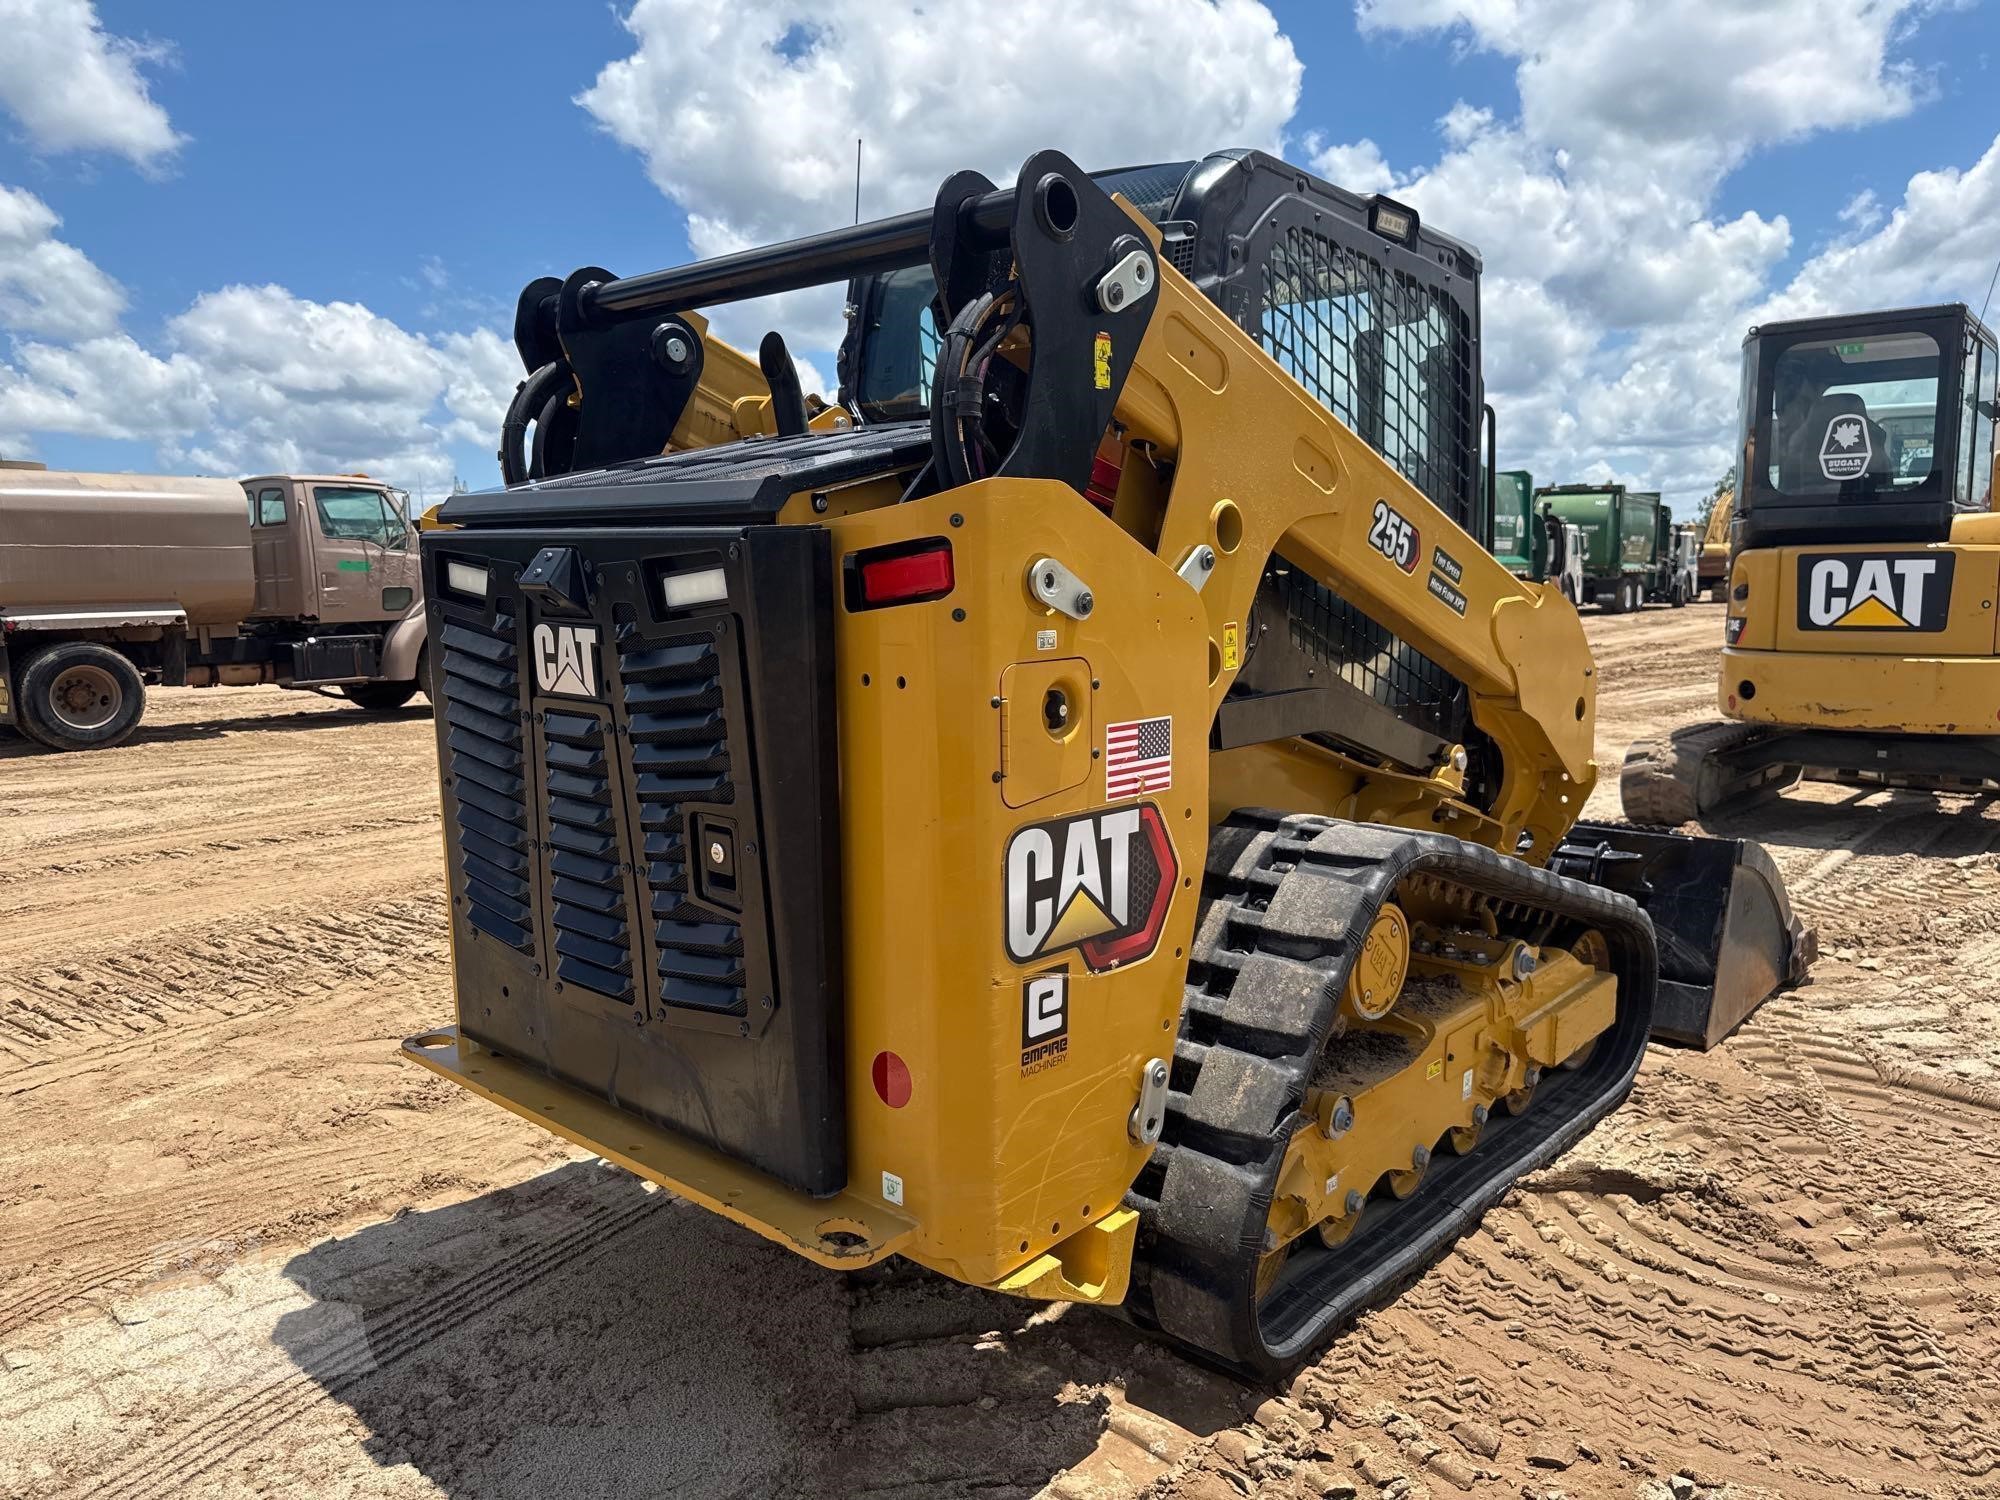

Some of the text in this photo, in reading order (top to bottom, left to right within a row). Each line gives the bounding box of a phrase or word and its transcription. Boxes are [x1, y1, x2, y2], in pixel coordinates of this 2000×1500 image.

[1828, 459, 1862, 467] SUGAR
[1369, 502, 1413, 565] 255
[1808, 559, 1937, 627] CAT
[533, 623, 596, 697] CAT
[1008, 808, 1140, 958] CAT
[1020, 1053, 1068, 1079] MACHINERY
